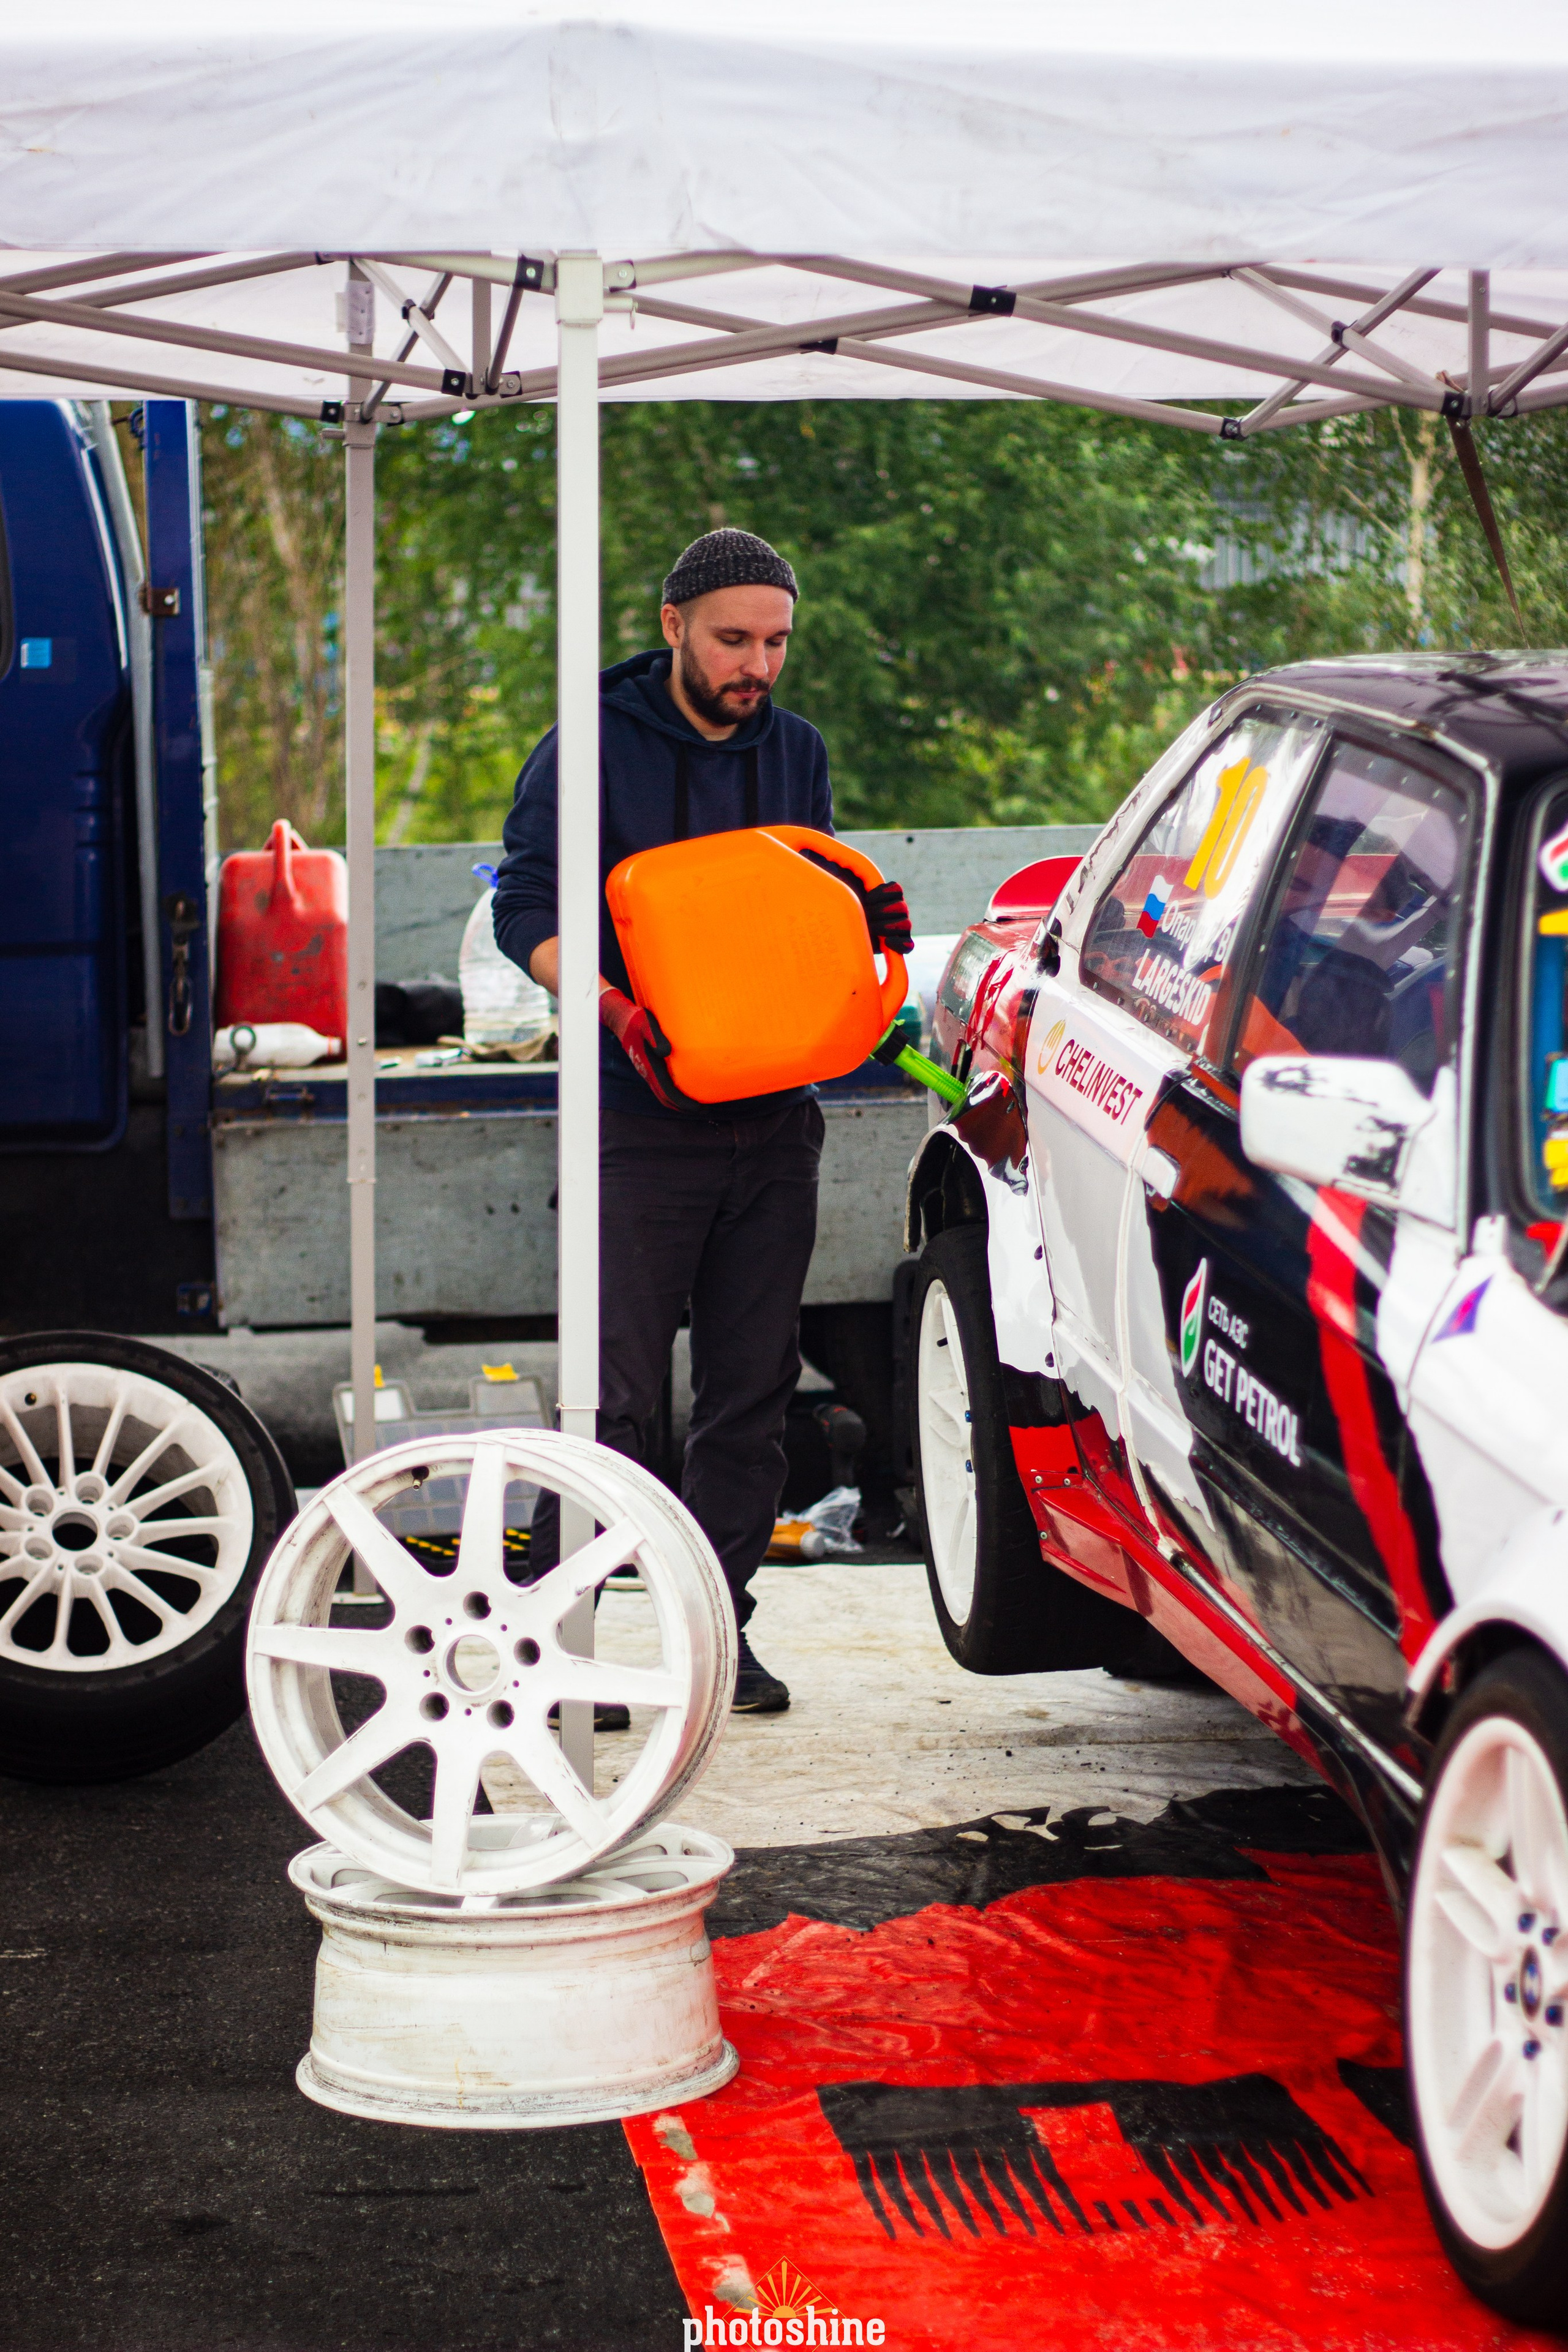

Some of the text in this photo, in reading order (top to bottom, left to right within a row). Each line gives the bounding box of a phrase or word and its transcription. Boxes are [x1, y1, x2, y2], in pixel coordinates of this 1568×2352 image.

[1183, 756, 1268, 900] 10
[1132, 948, 1212, 1026] LARGESKID
[1055, 1039, 1143, 1126] CHELINVEST
[1208, 1296, 1248, 1349] СЕТЬ АЗС
[1204, 1338, 1301, 1468] GET PETROL
